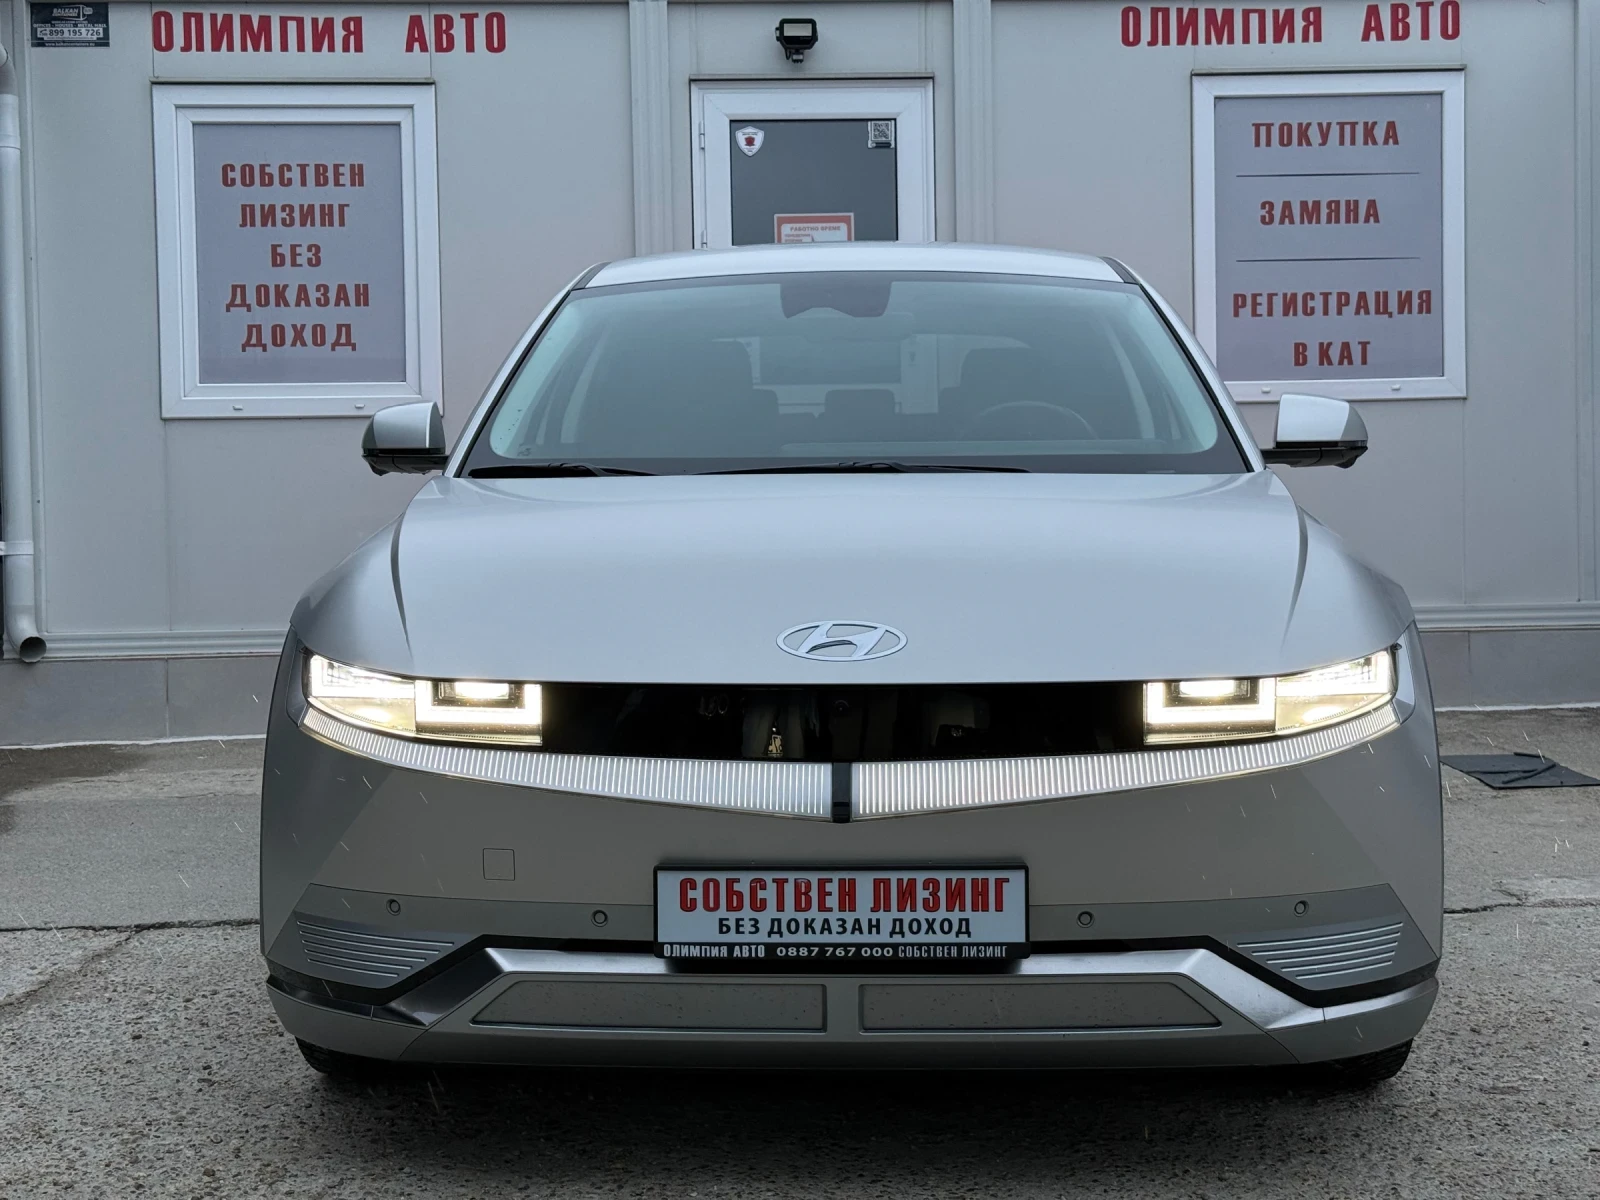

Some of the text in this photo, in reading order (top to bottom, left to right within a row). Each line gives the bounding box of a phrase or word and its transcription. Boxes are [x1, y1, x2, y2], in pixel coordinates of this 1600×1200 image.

[152, 11, 506, 54] ОЛИМПИЯ АВТО
[1121, 0, 1461, 47] ОЛИМПИЯ АВТО
[1252, 121, 1399, 148] ПОКУПКА
[221, 163, 365, 187] СОБСТВЕН
[239, 204, 350, 228] ЛИЗИНГ
[1260, 199, 1380, 226] ЗАМЯНА
[270, 243, 322, 267] БЕЗ
[225, 283, 370, 312] ДОКАЗАН
[1232, 290, 1432, 318] РЕГИСТРАЦИЯ
[241, 323, 356, 352] ДОХОД
[1293, 340, 1371, 367] В КАТ
[679, 877, 1010, 912] СОБСТВЕН ЛИЗИНГ
[718, 917, 972, 938] БЕЗ ДОКАЗАН ДОХОД
[663, 944, 1008, 957] ОЛИМПИЯ АВТО 0887 767 000 СОБСТВЕН ЛИЗИНГ
